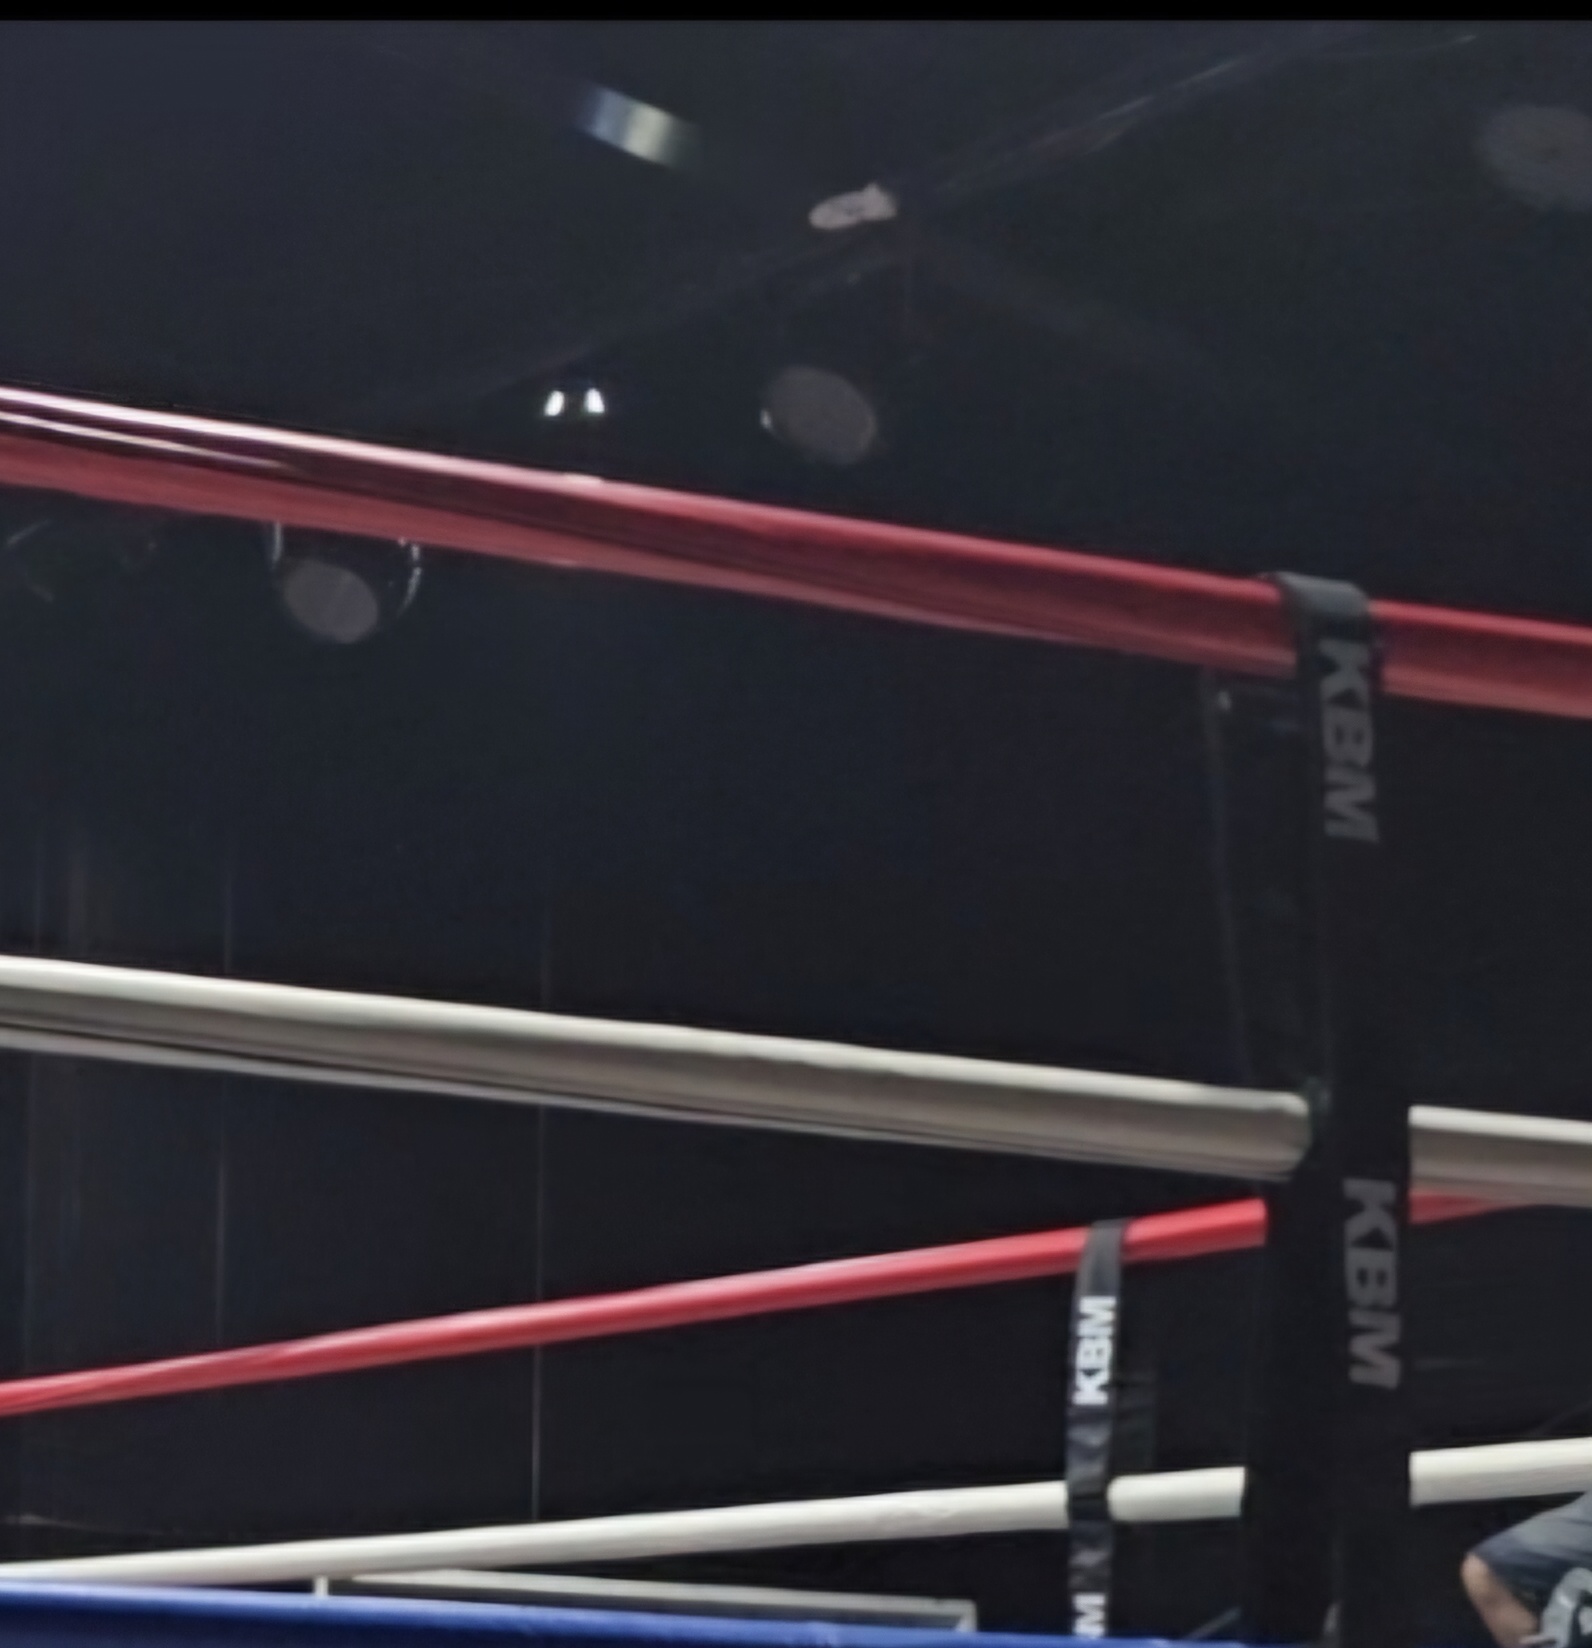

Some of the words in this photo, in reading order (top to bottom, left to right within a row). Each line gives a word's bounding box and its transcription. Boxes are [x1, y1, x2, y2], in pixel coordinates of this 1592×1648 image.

[1319, 639, 1379, 843] KBM
[1072, 1296, 1116, 1405] KBM
[1343, 1177, 1401, 1388] KBM
